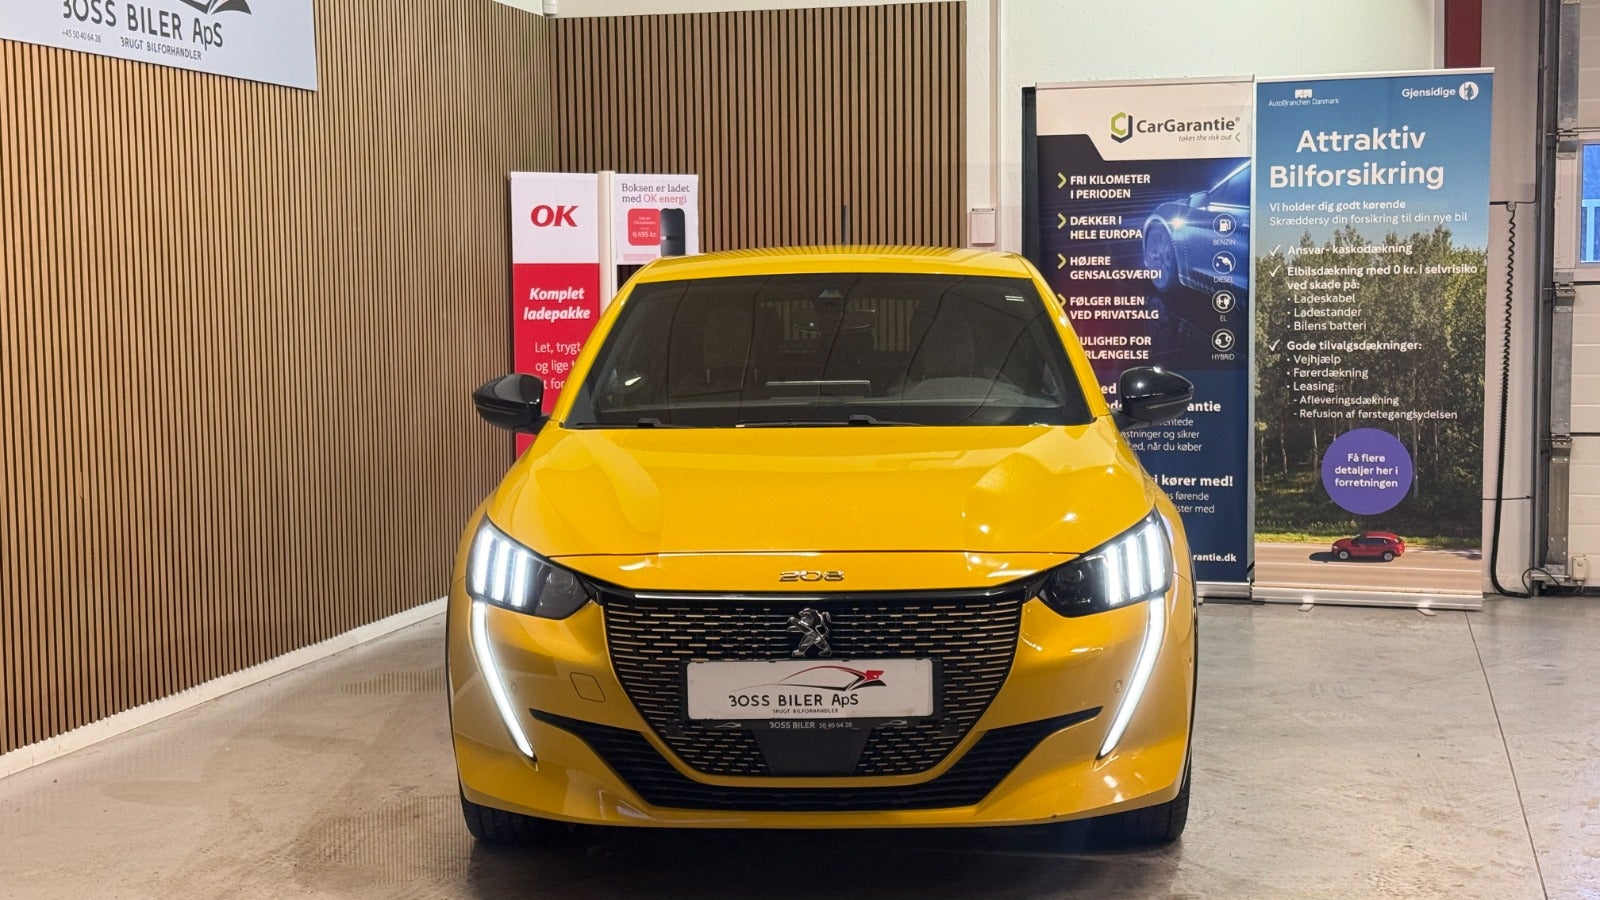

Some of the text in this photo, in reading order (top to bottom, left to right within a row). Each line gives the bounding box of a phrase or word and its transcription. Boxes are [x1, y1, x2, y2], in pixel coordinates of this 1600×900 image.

[127, 3, 183, 41] BILER
[192, 17, 224, 54] ApS
[147, 41, 202, 60] BILFORHANDLER
[1401, 87, 1456, 102] Gjensidige
[1268, 97, 1340, 107] AutoBranchen Danmark
[1179, 134, 1232, 142] takes the risk out
[1296, 125, 1427, 153] Attraktiv
[1070, 174, 1151, 185] FRI KILOMETER
[1269, 161, 1445, 190] Bilforsikring
[621, 182, 691, 193] Boksen er ladet
[621, 194, 687, 205] med OK energi
[1070, 189, 1131, 199] I PERIODEN
[1270, 200, 1406, 213] Vi holder dig godt kørende
[530, 204, 579, 228] OK
[1070, 216, 1122, 226] DÆKKER I
[1269, 212, 1468, 227] Skræddersy din forsikring til din nye bil
[1070, 229, 1143, 240] HELE EUROPA
[1212, 238, 1236, 246] BENZIN
[1287, 243, 1413, 256] Ansvar- kaskodækning
[1070, 256, 1111, 266] HØJERE
[1070, 269, 1162, 280] GENSALGSVÆRDI
[1287, 265, 1364, 279] Elbilsdækning
[1366, 265, 1391, 275] med
[1393, 265, 1401, 274] 0
[1403, 265, 1417, 274] kr.
[1425, 264, 1478, 274] selvrisiko
[1213, 275, 1234, 283] DIESEL
[1287, 280, 1360, 292] ved skade på:
[529, 287, 584, 302] Komplet
[1294, 294, 1356, 304] Ladeskabel
[1070, 296, 1145, 306] FØLGER BILEN
[523, 306, 590, 323] ladepakke
[1070, 309, 1159, 320] VED PRIVATSALG
[1294, 307, 1362, 317] Ladestander
[1219, 314, 1227, 322] EL
[1294, 321, 1367, 331] Bilens batteri
[1078, 336, 1151, 346] ULIGHED FOR
[1286, 340, 1422, 353] Gode tilvalgsdækninger:
[534, 343, 582, 355] Let, trygt
[1085, 350, 1149, 360] RLÆNGELSE
[1294, 355, 1341, 365] Vejhjælp
[535, 362, 548, 373] og
[551, 360, 568, 373] lige
[1294, 368, 1368, 380] Førerdækning
[1294, 382, 1337, 393] Leasing:
[1299, 395, 1399, 407] Afleveringsdækning
[1299, 409, 1458, 421] Refusion af førstegangsydelsen
[1163, 431, 1175, 441] og
[1177, 430, 1200, 439] sikrer
[1147, 442, 1161, 452] når
[1163, 442, 1175, 452] du
[1177, 442, 1202, 452] køber
[1347, 453, 1386, 463] Få flere
[1334, 465, 1374, 476] detaljer
[1376, 465, 1393, 475] her
[1161, 475, 1197, 486] kører
[1200, 475, 1233, 486] med!
[1334, 478, 1398, 488] forretningen
[1176, 492, 1209, 501] førende
[1195, 505, 1215, 513] med
[779, 570, 844, 582] 208
[778, 694, 823, 707] BILER
[831, 693, 859, 708] ApS
[792, 721, 815, 729] BILER
